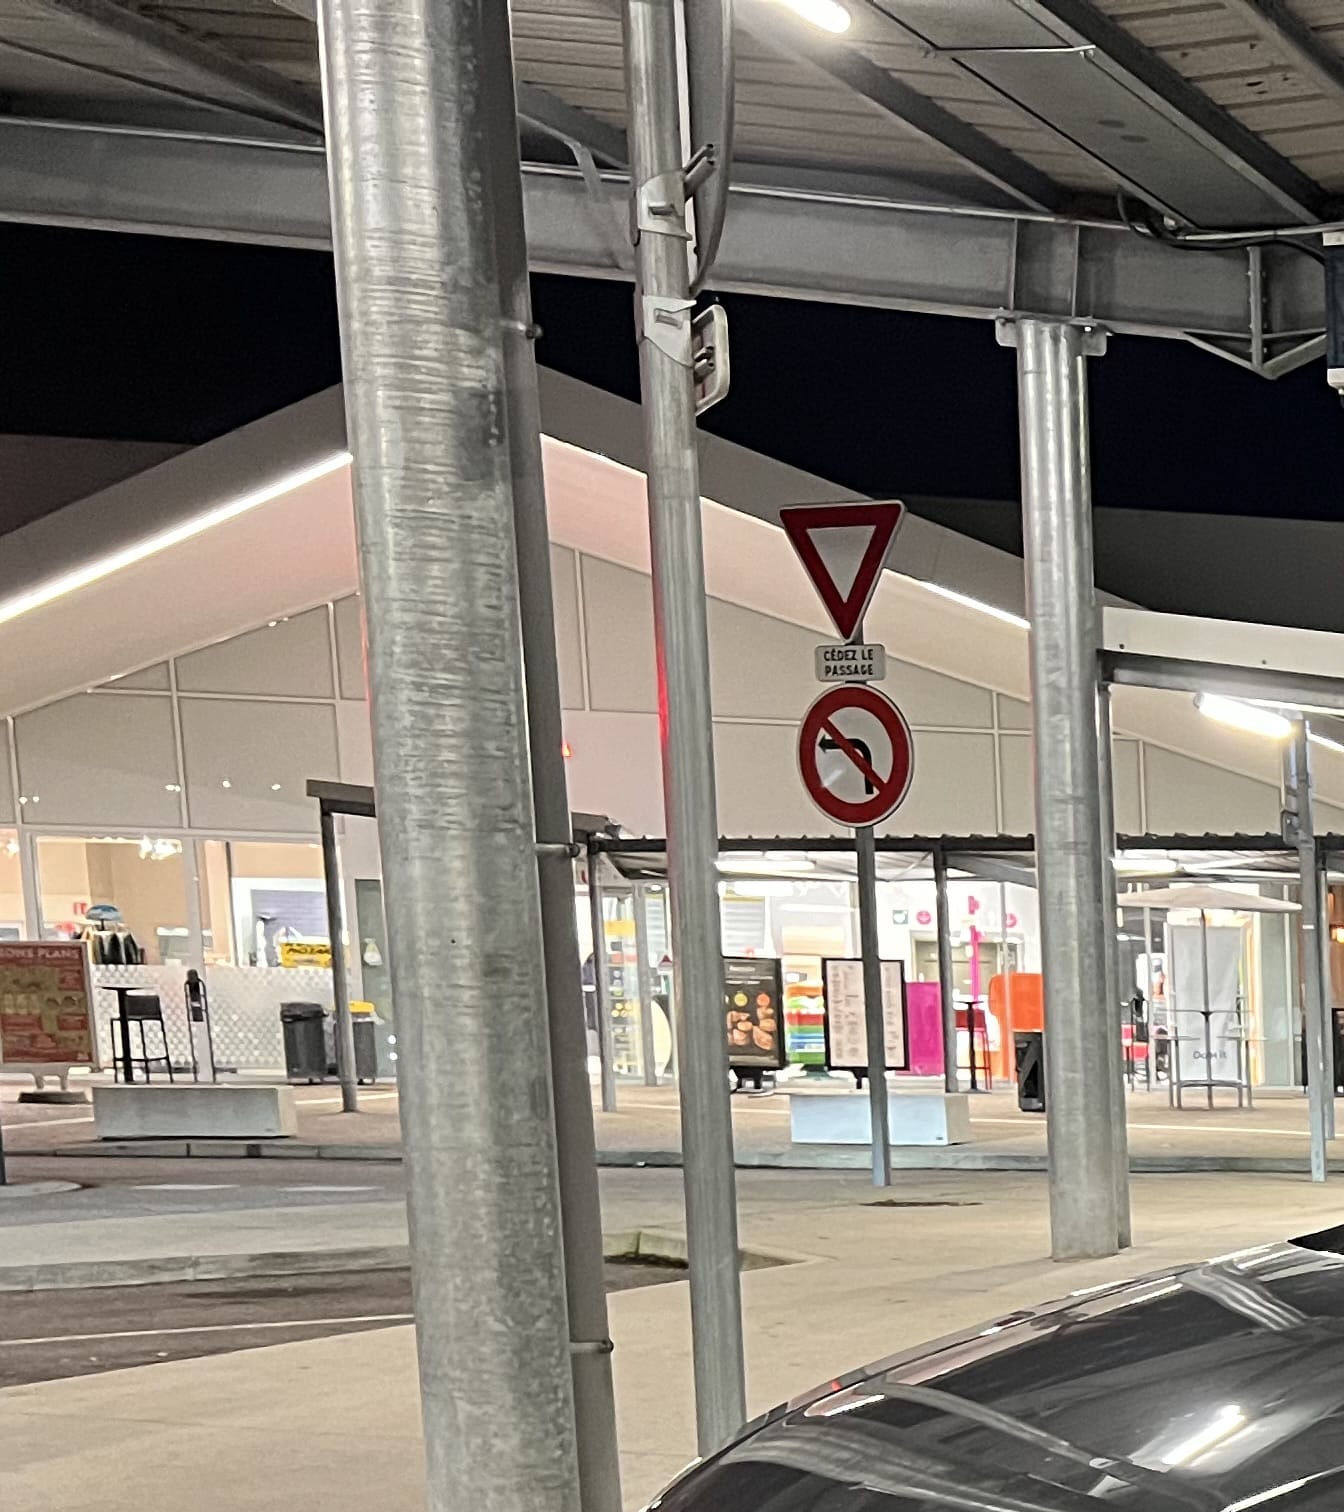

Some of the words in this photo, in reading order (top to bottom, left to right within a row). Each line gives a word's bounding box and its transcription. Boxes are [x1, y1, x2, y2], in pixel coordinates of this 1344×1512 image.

[824, 648, 857, 661] CÉDEZ
[862, 649, 873, 660] LE
[825, 664, 873, 676] PASSAGE
